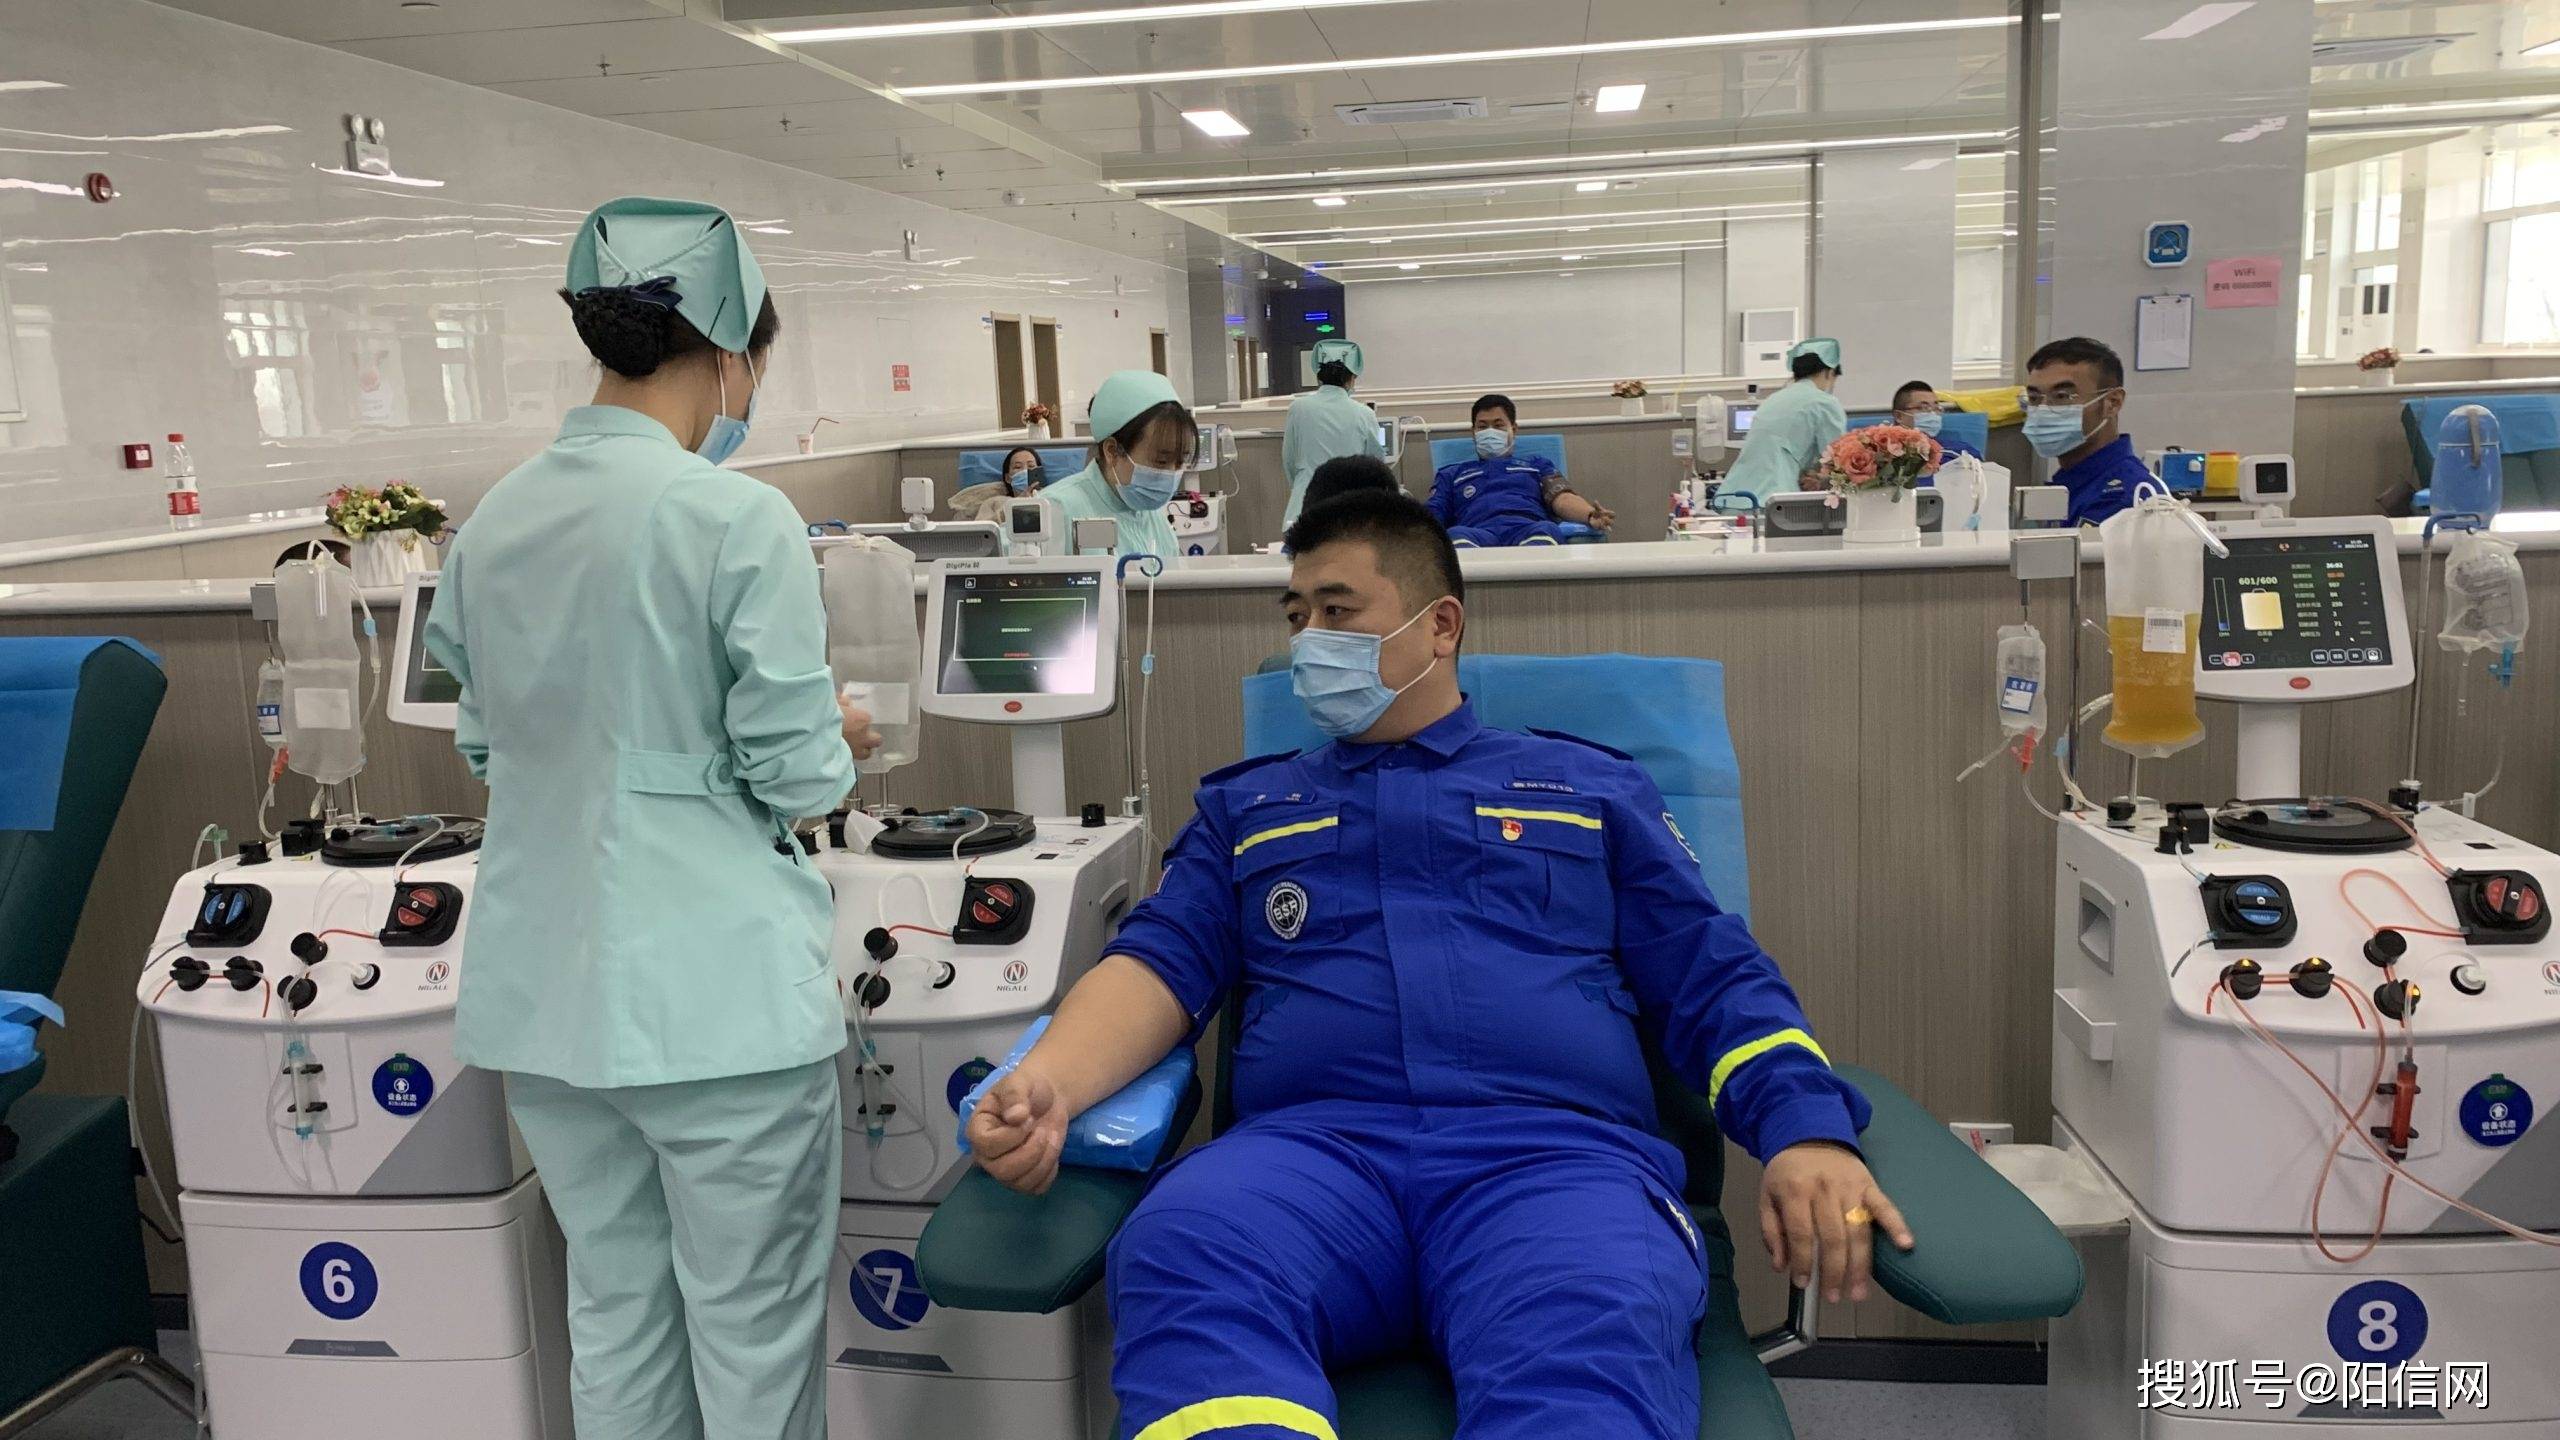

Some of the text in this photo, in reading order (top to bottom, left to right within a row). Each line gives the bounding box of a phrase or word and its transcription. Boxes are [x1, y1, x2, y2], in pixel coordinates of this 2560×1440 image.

[2234, 268, 2256, 277] WiFi
[2238, 576, 2278, 586] 601/600
[322, 1259, 355, 1304] 6
[874, 1267, 903, 1312] 7
[2357, 1300, 2398, 1352] 8
